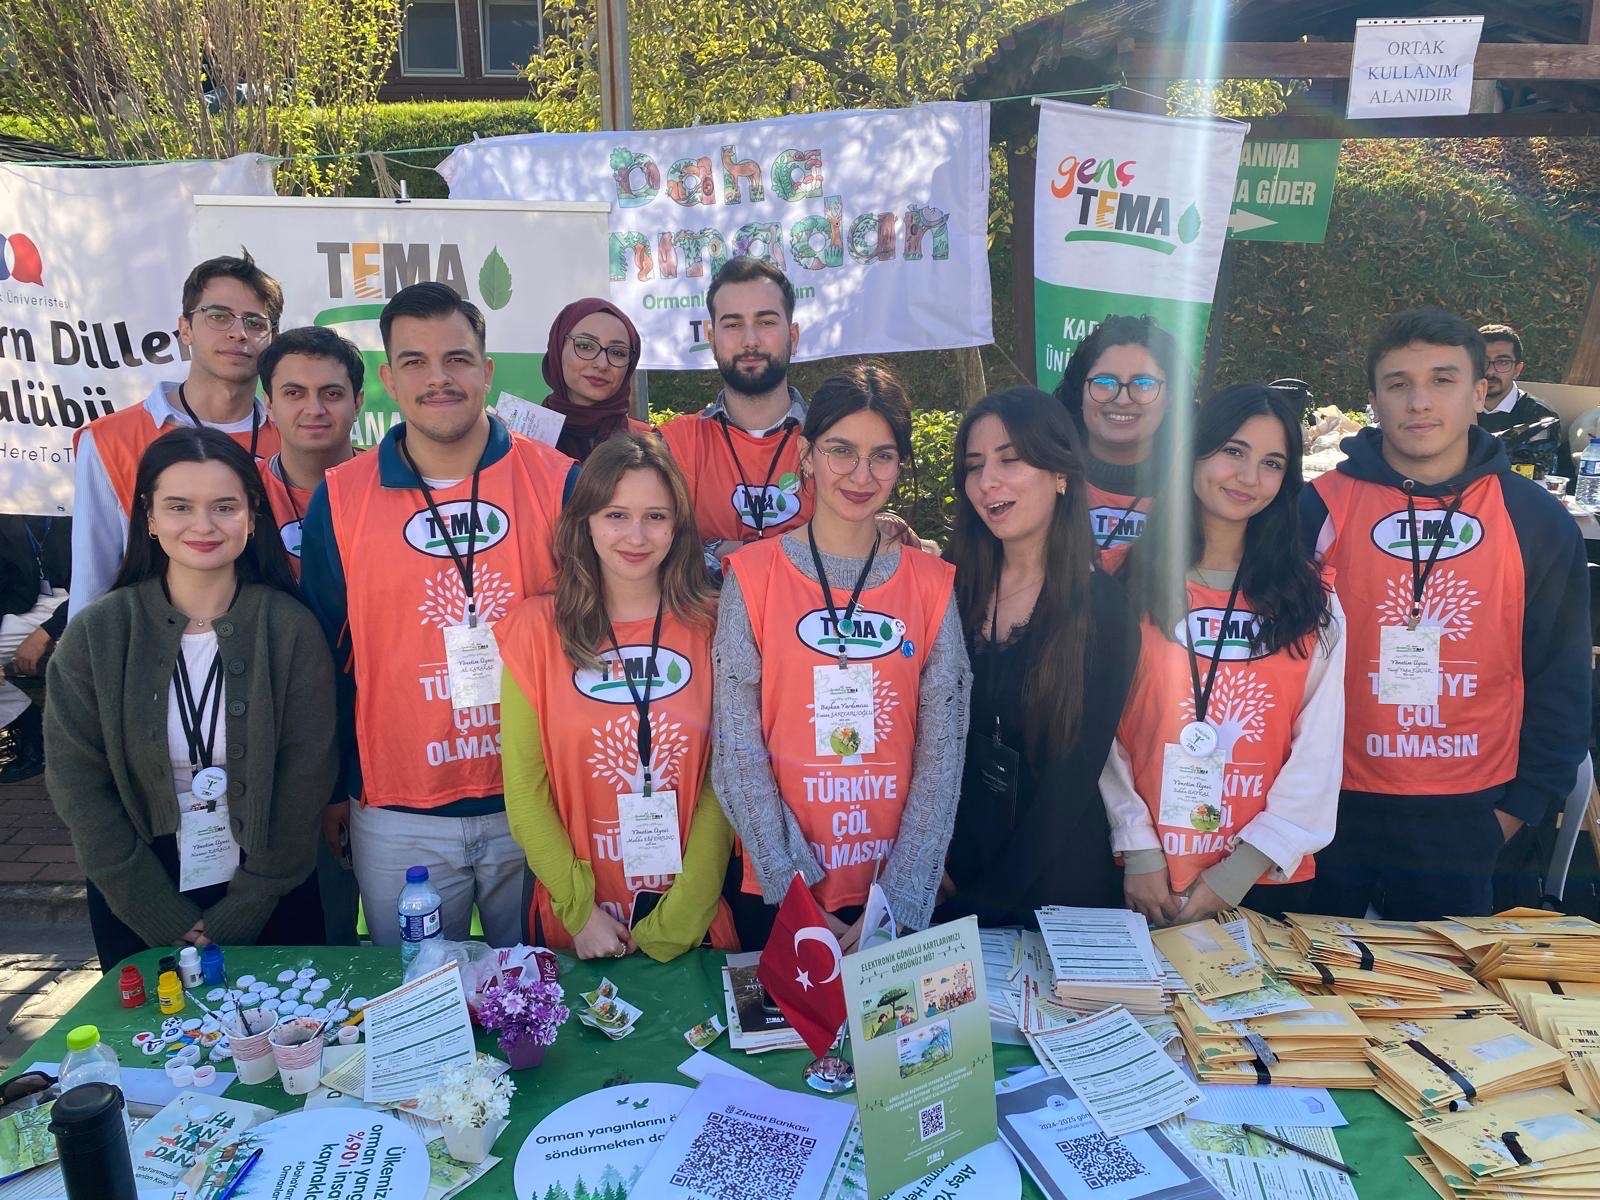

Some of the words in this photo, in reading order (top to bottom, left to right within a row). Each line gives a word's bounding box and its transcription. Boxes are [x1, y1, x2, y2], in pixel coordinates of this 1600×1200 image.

[1387, 40, 1445, 56] ORTAK
[1368, 64, 1459, 81] KULLANIM
[1370, 88, 1453, 104] ALANIDIR
[1240, 143, 1299, 169] ANMA
[1051, 156, 1137, 199] genç
[1076, 187, 1170, 236] TEMA
[316, 241, 470, 299] TEMA
[50, 320, 192, 370] Diller
[820, 616, 877, 639] TMA
[1196, 616, 1257, 641] TEMA
[600, 656, 660, 681] TEMA
[1366, 733, 1478, 758] OLMASIN
[803, 769, 897, 804] TÜRKİYE
[832, 805, 871, 842] ÇÖL
[811, 838, 896, 871] OLMASIN
[861, 952, 895, 973] ELEKTRONİK
[896, 943, 922, 961] GÖNÜLLÜ
[922, 932, 960, 953] KARTLARIMIZI
[891, 956, 922, 974] GÖRDÜNÜZ
[535, 1128, 585, 1145] Orman
[587, 1117, 667, 1138] yangınlarını
[736, 1108, 767, 1122] Ziraat
[769, 1115, 811, 1133] Bankası
[364, 1124, 384, 1165] orman
[545, 1136, 645, 1161] söndürmekten
[949, 1163, 977, 1190] Ateş
